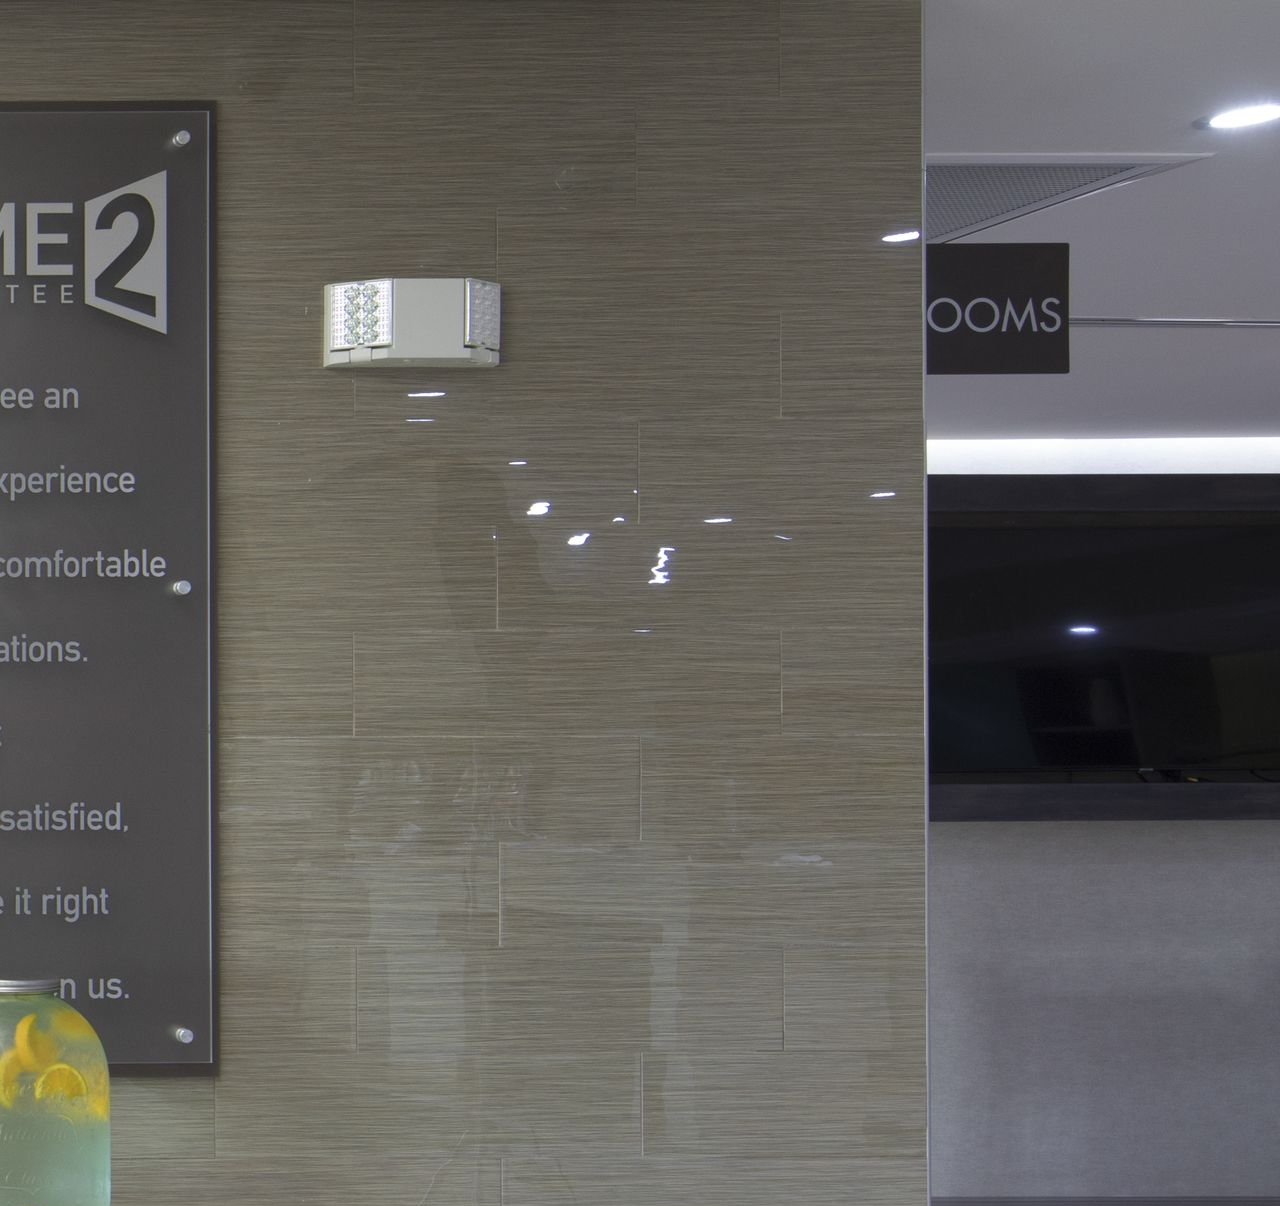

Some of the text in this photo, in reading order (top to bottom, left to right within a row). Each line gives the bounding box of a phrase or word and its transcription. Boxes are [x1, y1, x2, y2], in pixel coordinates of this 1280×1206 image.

[927, 297, 1062, 333] OOMS
[44, 388, 79, 409] an
[0, 802, 129, 833] satisfied,
[15, 886, 31, 915] it
[42, 886, 109, 923] right
[88, 978, 130, 1000] us.
